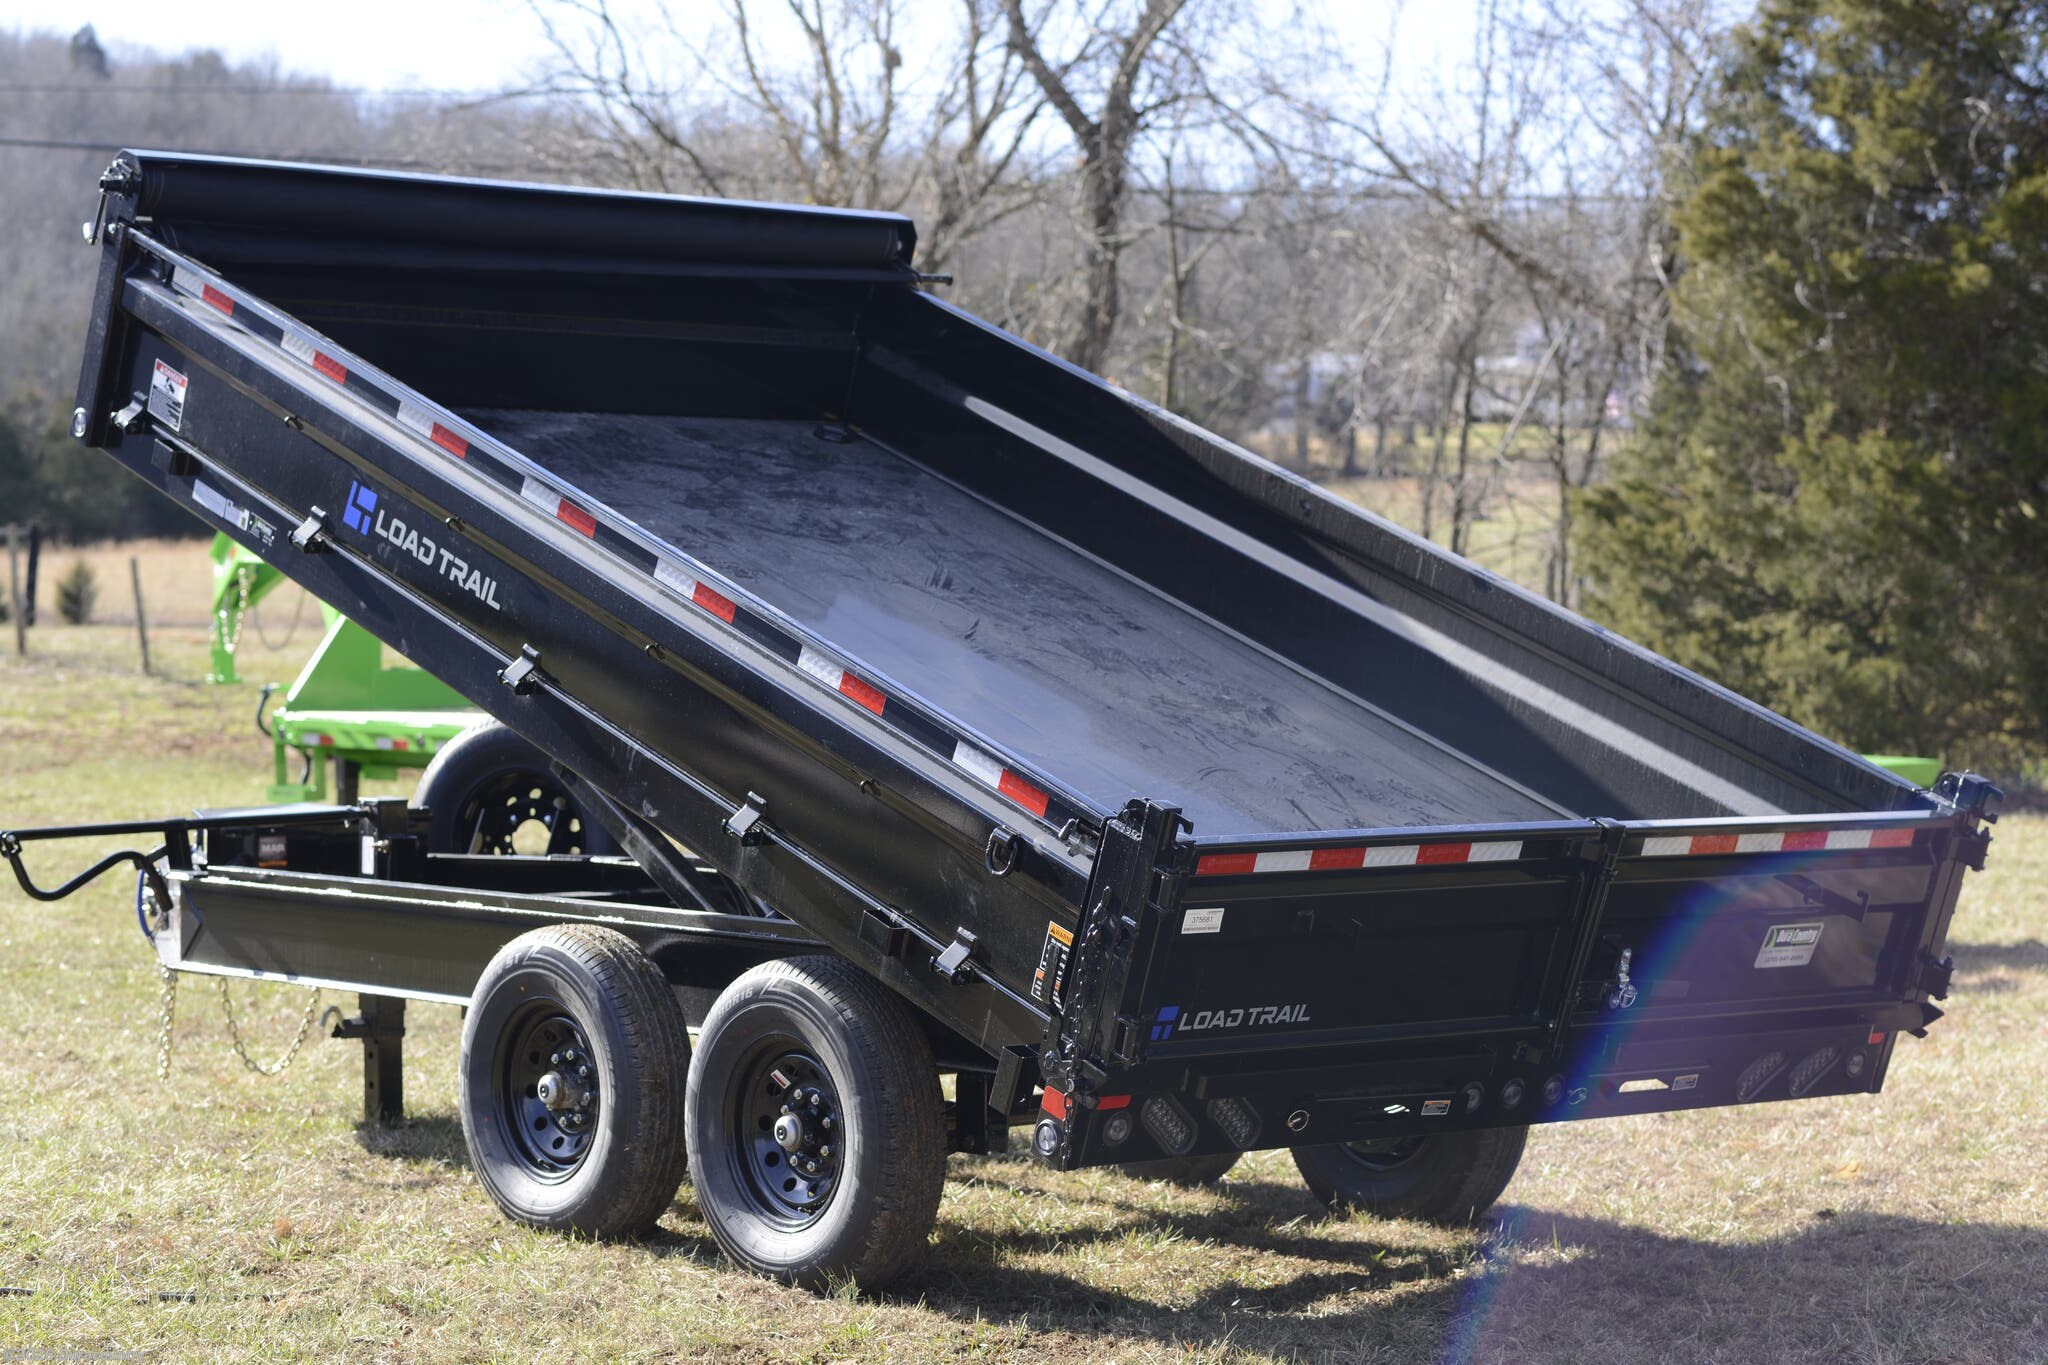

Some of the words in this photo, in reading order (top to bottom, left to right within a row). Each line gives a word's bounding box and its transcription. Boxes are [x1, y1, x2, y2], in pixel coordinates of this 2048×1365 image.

[374, 508, 436, 566] LOAD
[439, 547, 501, 611] TRAIL
[1178, 1009, 1244, 1031] LOAD
[1248, 1004, 1310, 1026] TRAIL
